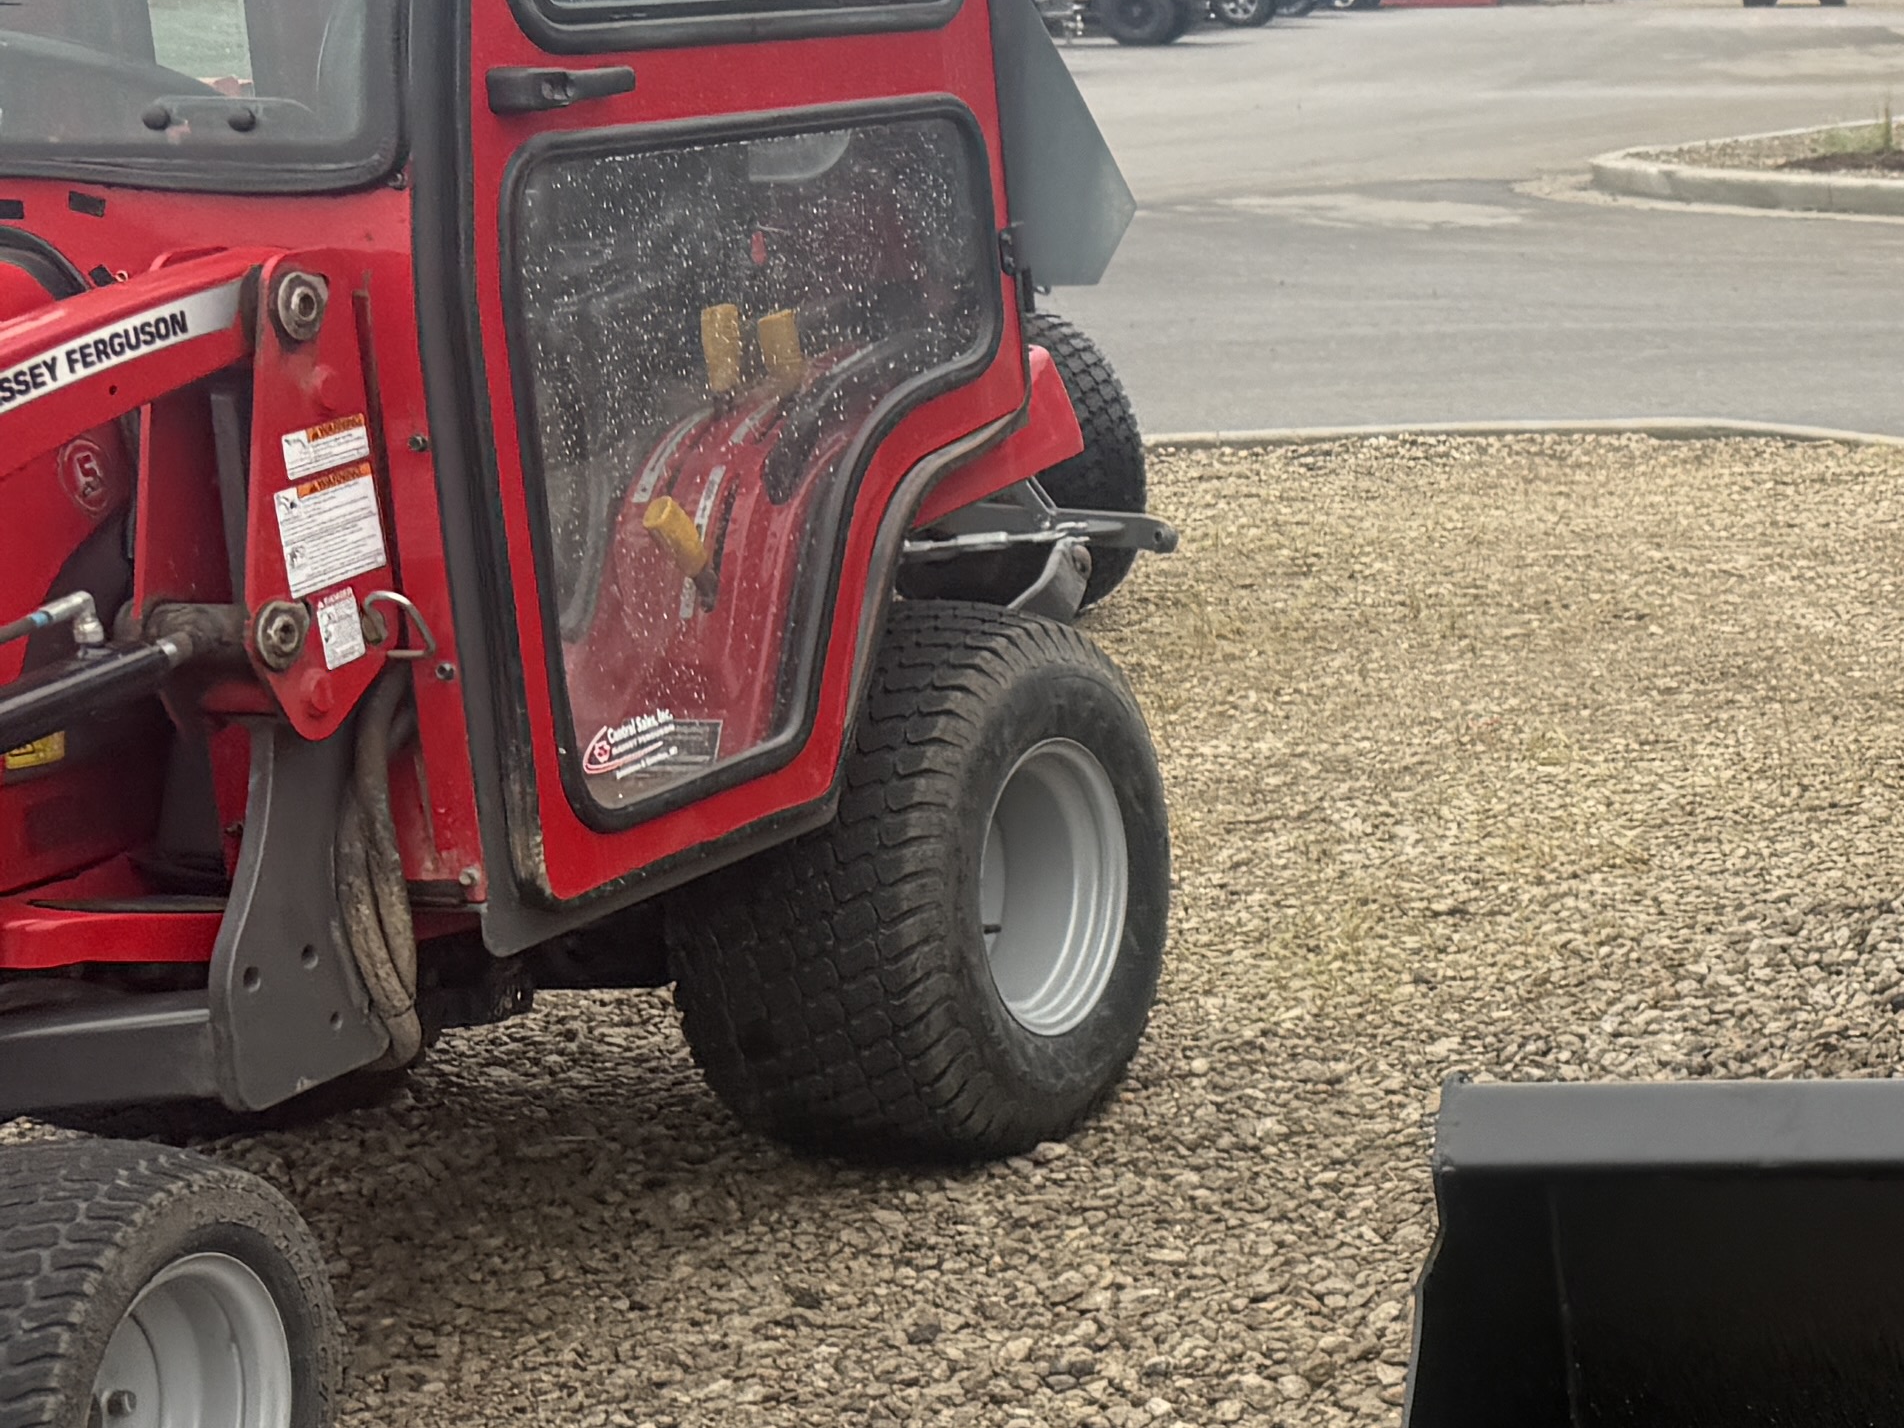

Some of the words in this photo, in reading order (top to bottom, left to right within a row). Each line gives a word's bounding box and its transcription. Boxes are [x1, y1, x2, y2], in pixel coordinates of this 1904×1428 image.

[0, 355, 59, 406] SSEY
[65, 309, 189, 374] FERGUSON
[607, 718, 637, 744] Central
